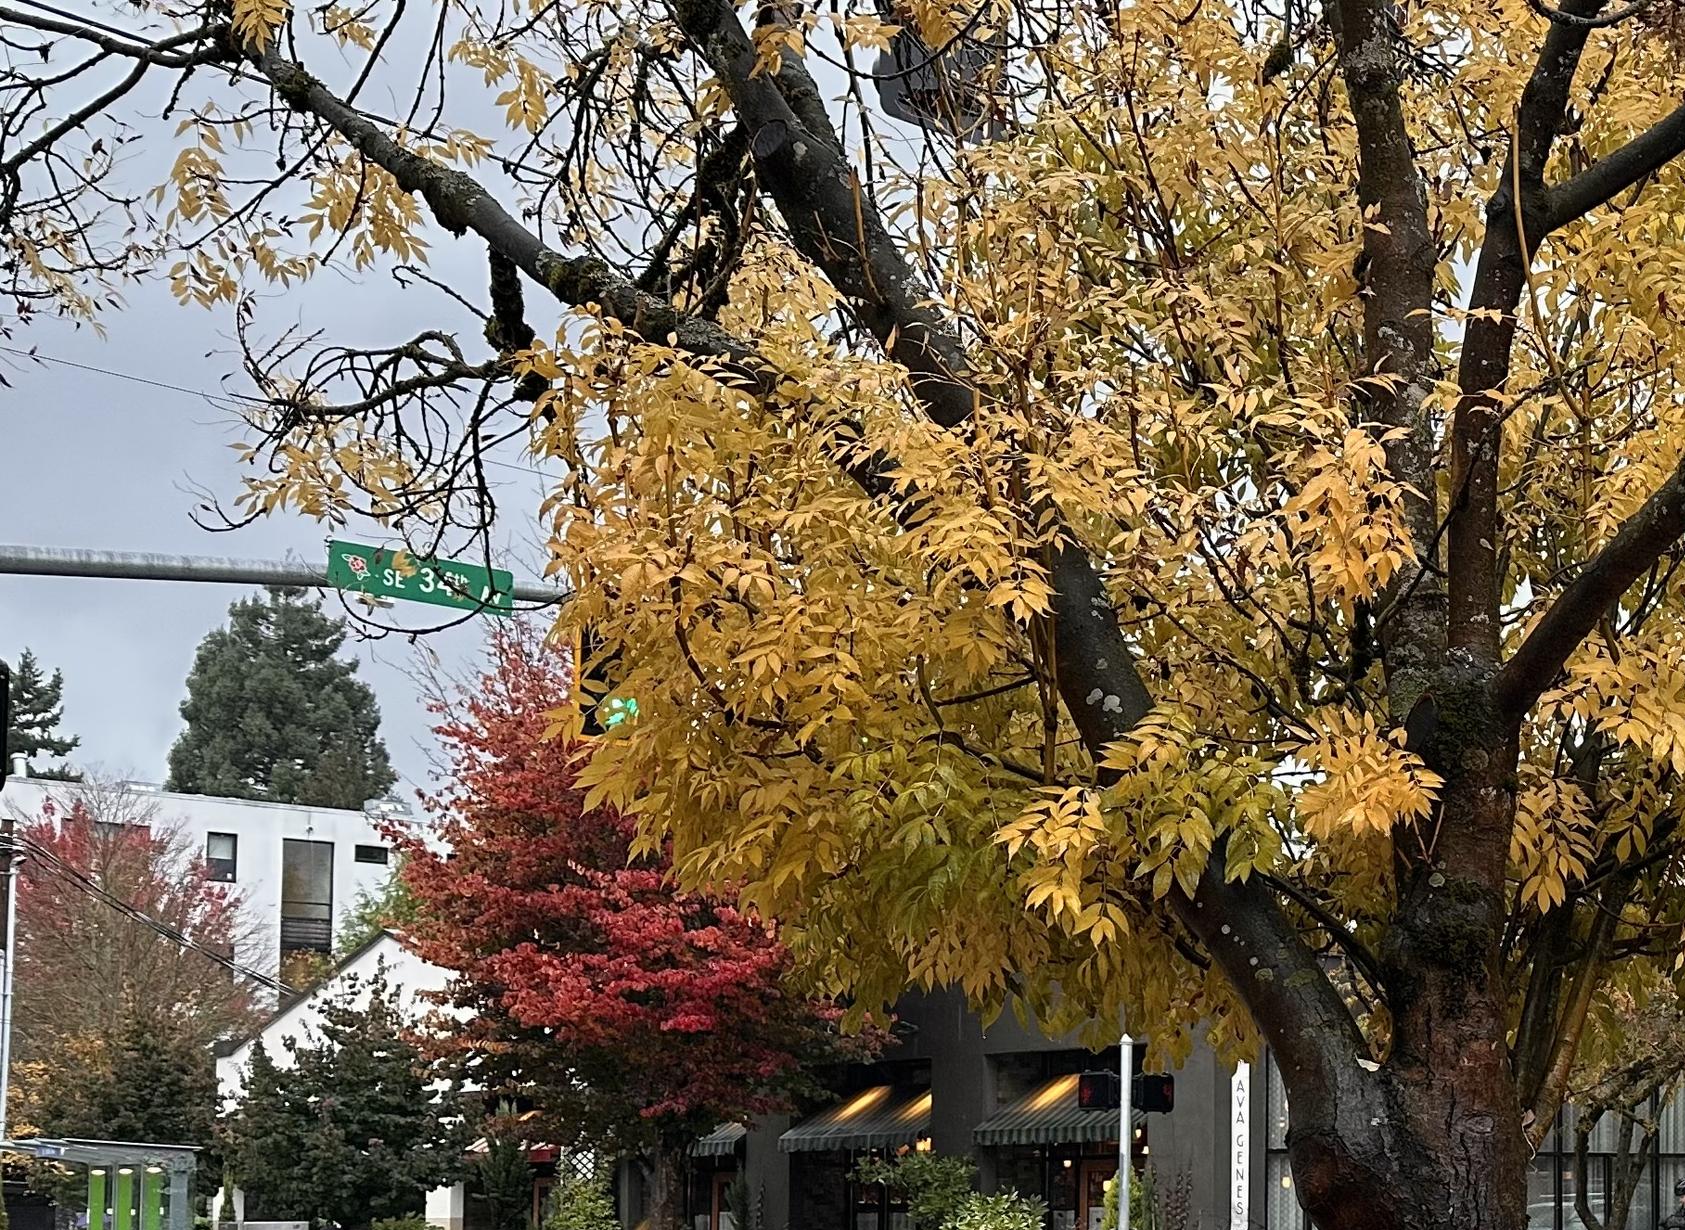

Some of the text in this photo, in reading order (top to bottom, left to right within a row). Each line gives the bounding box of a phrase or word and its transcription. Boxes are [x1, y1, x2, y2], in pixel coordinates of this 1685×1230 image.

[383, 568, 406, 589] SE
[1235, 1079, 1245, 1215] AVA GENES
